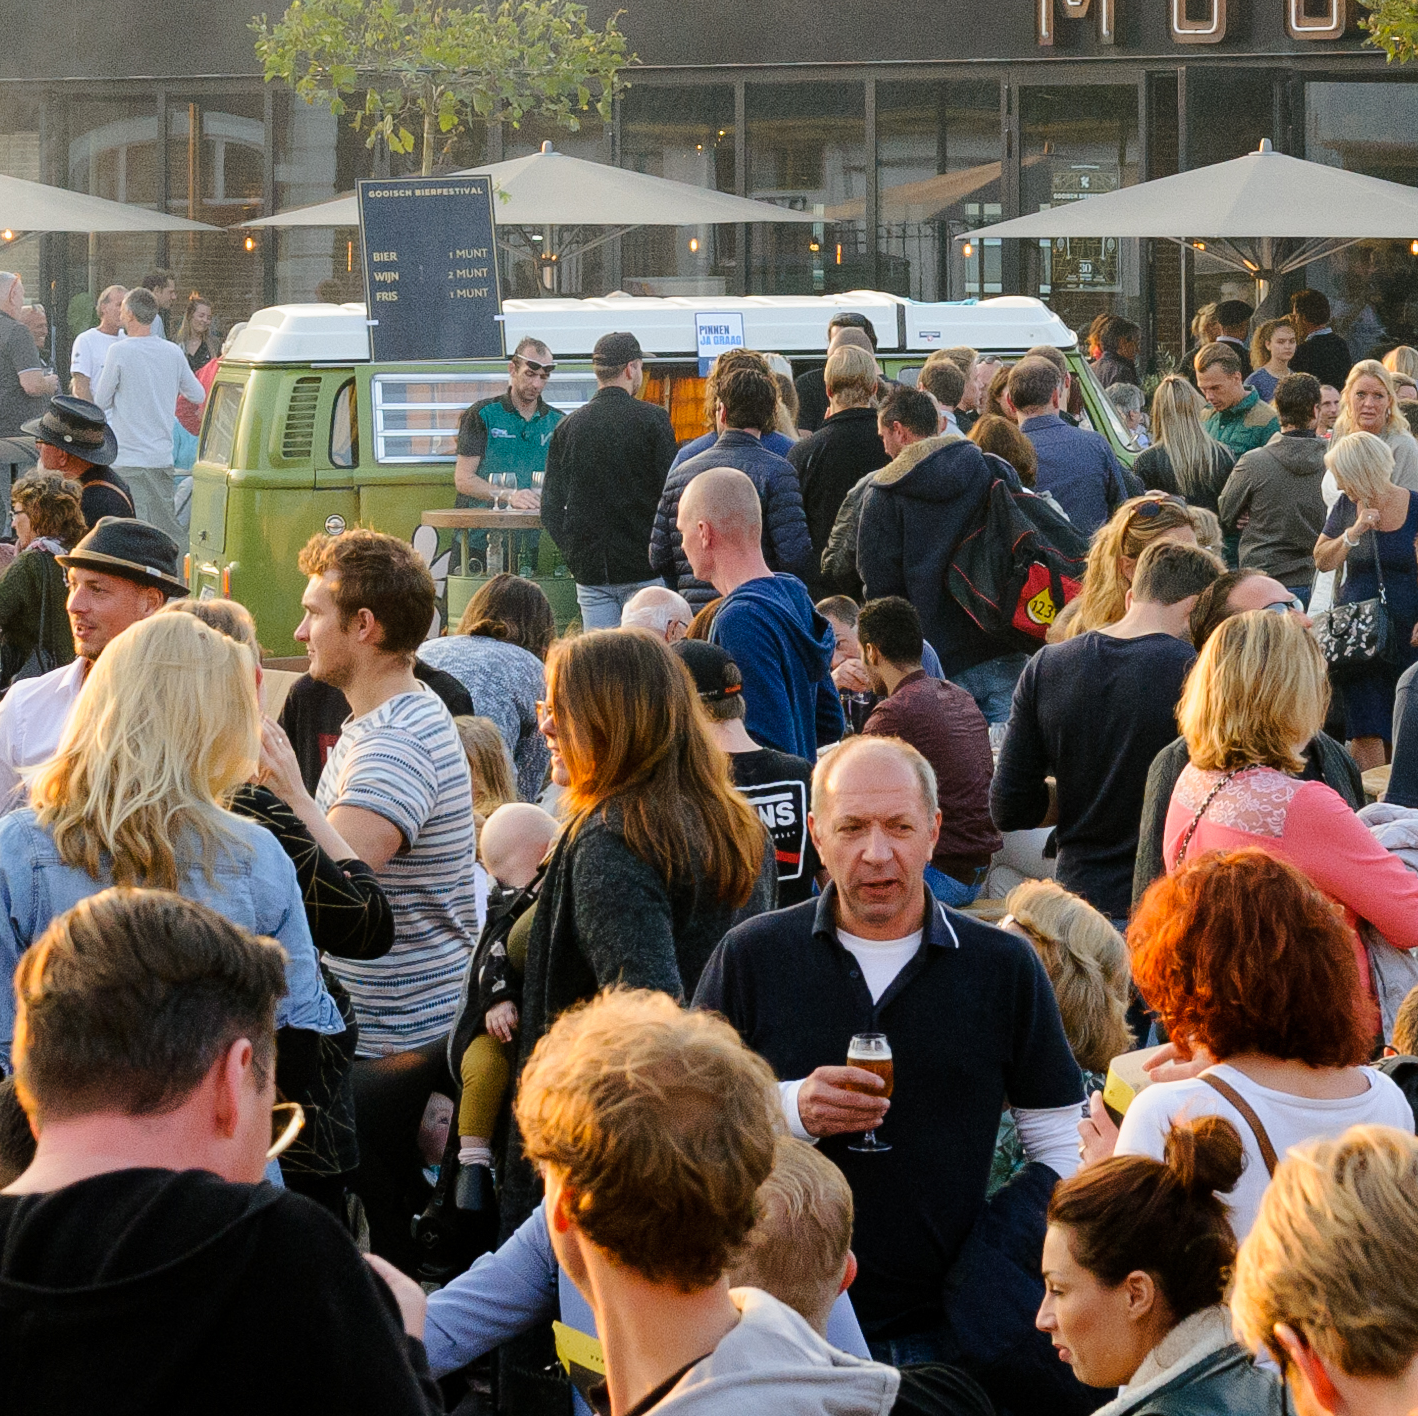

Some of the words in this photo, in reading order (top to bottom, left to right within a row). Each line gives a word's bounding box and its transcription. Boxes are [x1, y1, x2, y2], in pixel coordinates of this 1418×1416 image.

[368, 189, 412, 198] GOOISCH
[414, 186, 483, 196] BIERFESTIVAL
[372, 251, 398, 262] BIER
[456, 248, 488, 259] MUNT
[373, 271, 400, 284] WIJN
[447, 271, 454, 279] 2
[456, 267, 489, 279] MUNT
[376, 291, 399, 302] FRIS
[456, 287, 489, 299] MUNT
[698, 325, 730, 335] PINNEN
[699, 335, 711, 346] JA
[713, 335, 742, 346] GRAAG
[758, 801, 796, 829] NS
